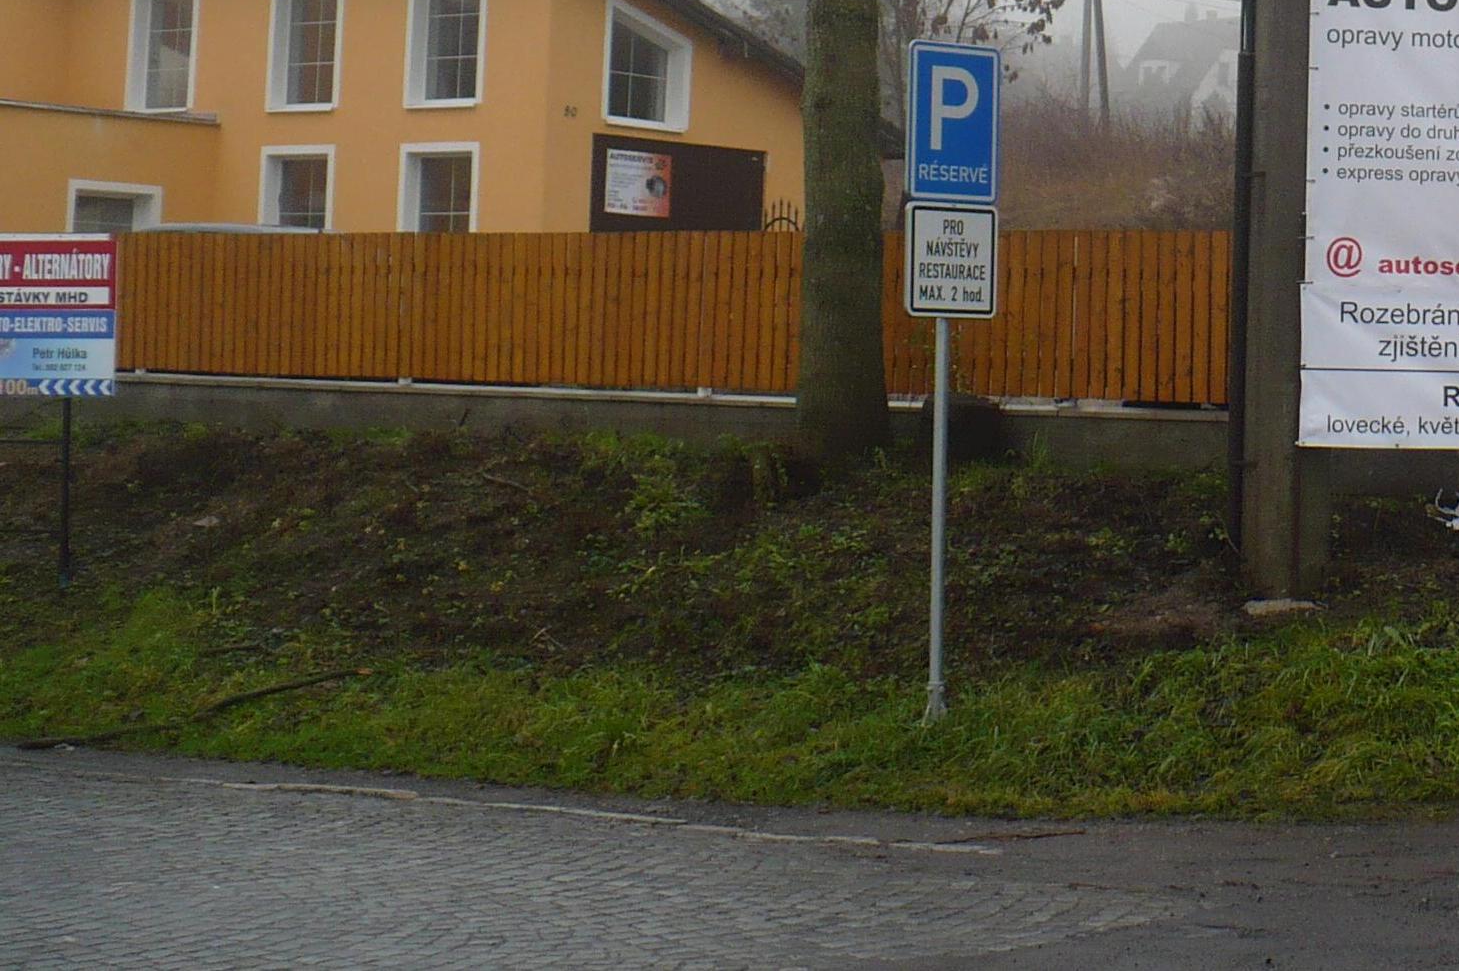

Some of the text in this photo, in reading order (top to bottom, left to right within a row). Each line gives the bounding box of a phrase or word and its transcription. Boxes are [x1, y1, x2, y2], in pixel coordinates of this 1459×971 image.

[1326, 29, 1403, 51] opravy
[930, 65, 979, 150] P
[1338, 102, 1395, 120] opravy
[1337, 124, 1395, 142] opravy
[1400, 124, 1421, 139] do
[1337, 144, 1441, 162] přezkoušení
[918, 160, 988, 184] RÉSERVÉ
[1336, 166, 1403, 183] express
[943, 219, 964, 236] PRO
[926, 236, 979, 258] NÁVŠTĚVY
[22, 248, 111, 279] ALTERNÁTORY
[918, 263, 986, 281] RESTAURACE
[55, 291, 89, 303] MHD
[919, 285, 985, 304] MAX. 2 hod.
[1326, 414, 1411, 437] lovecké,
